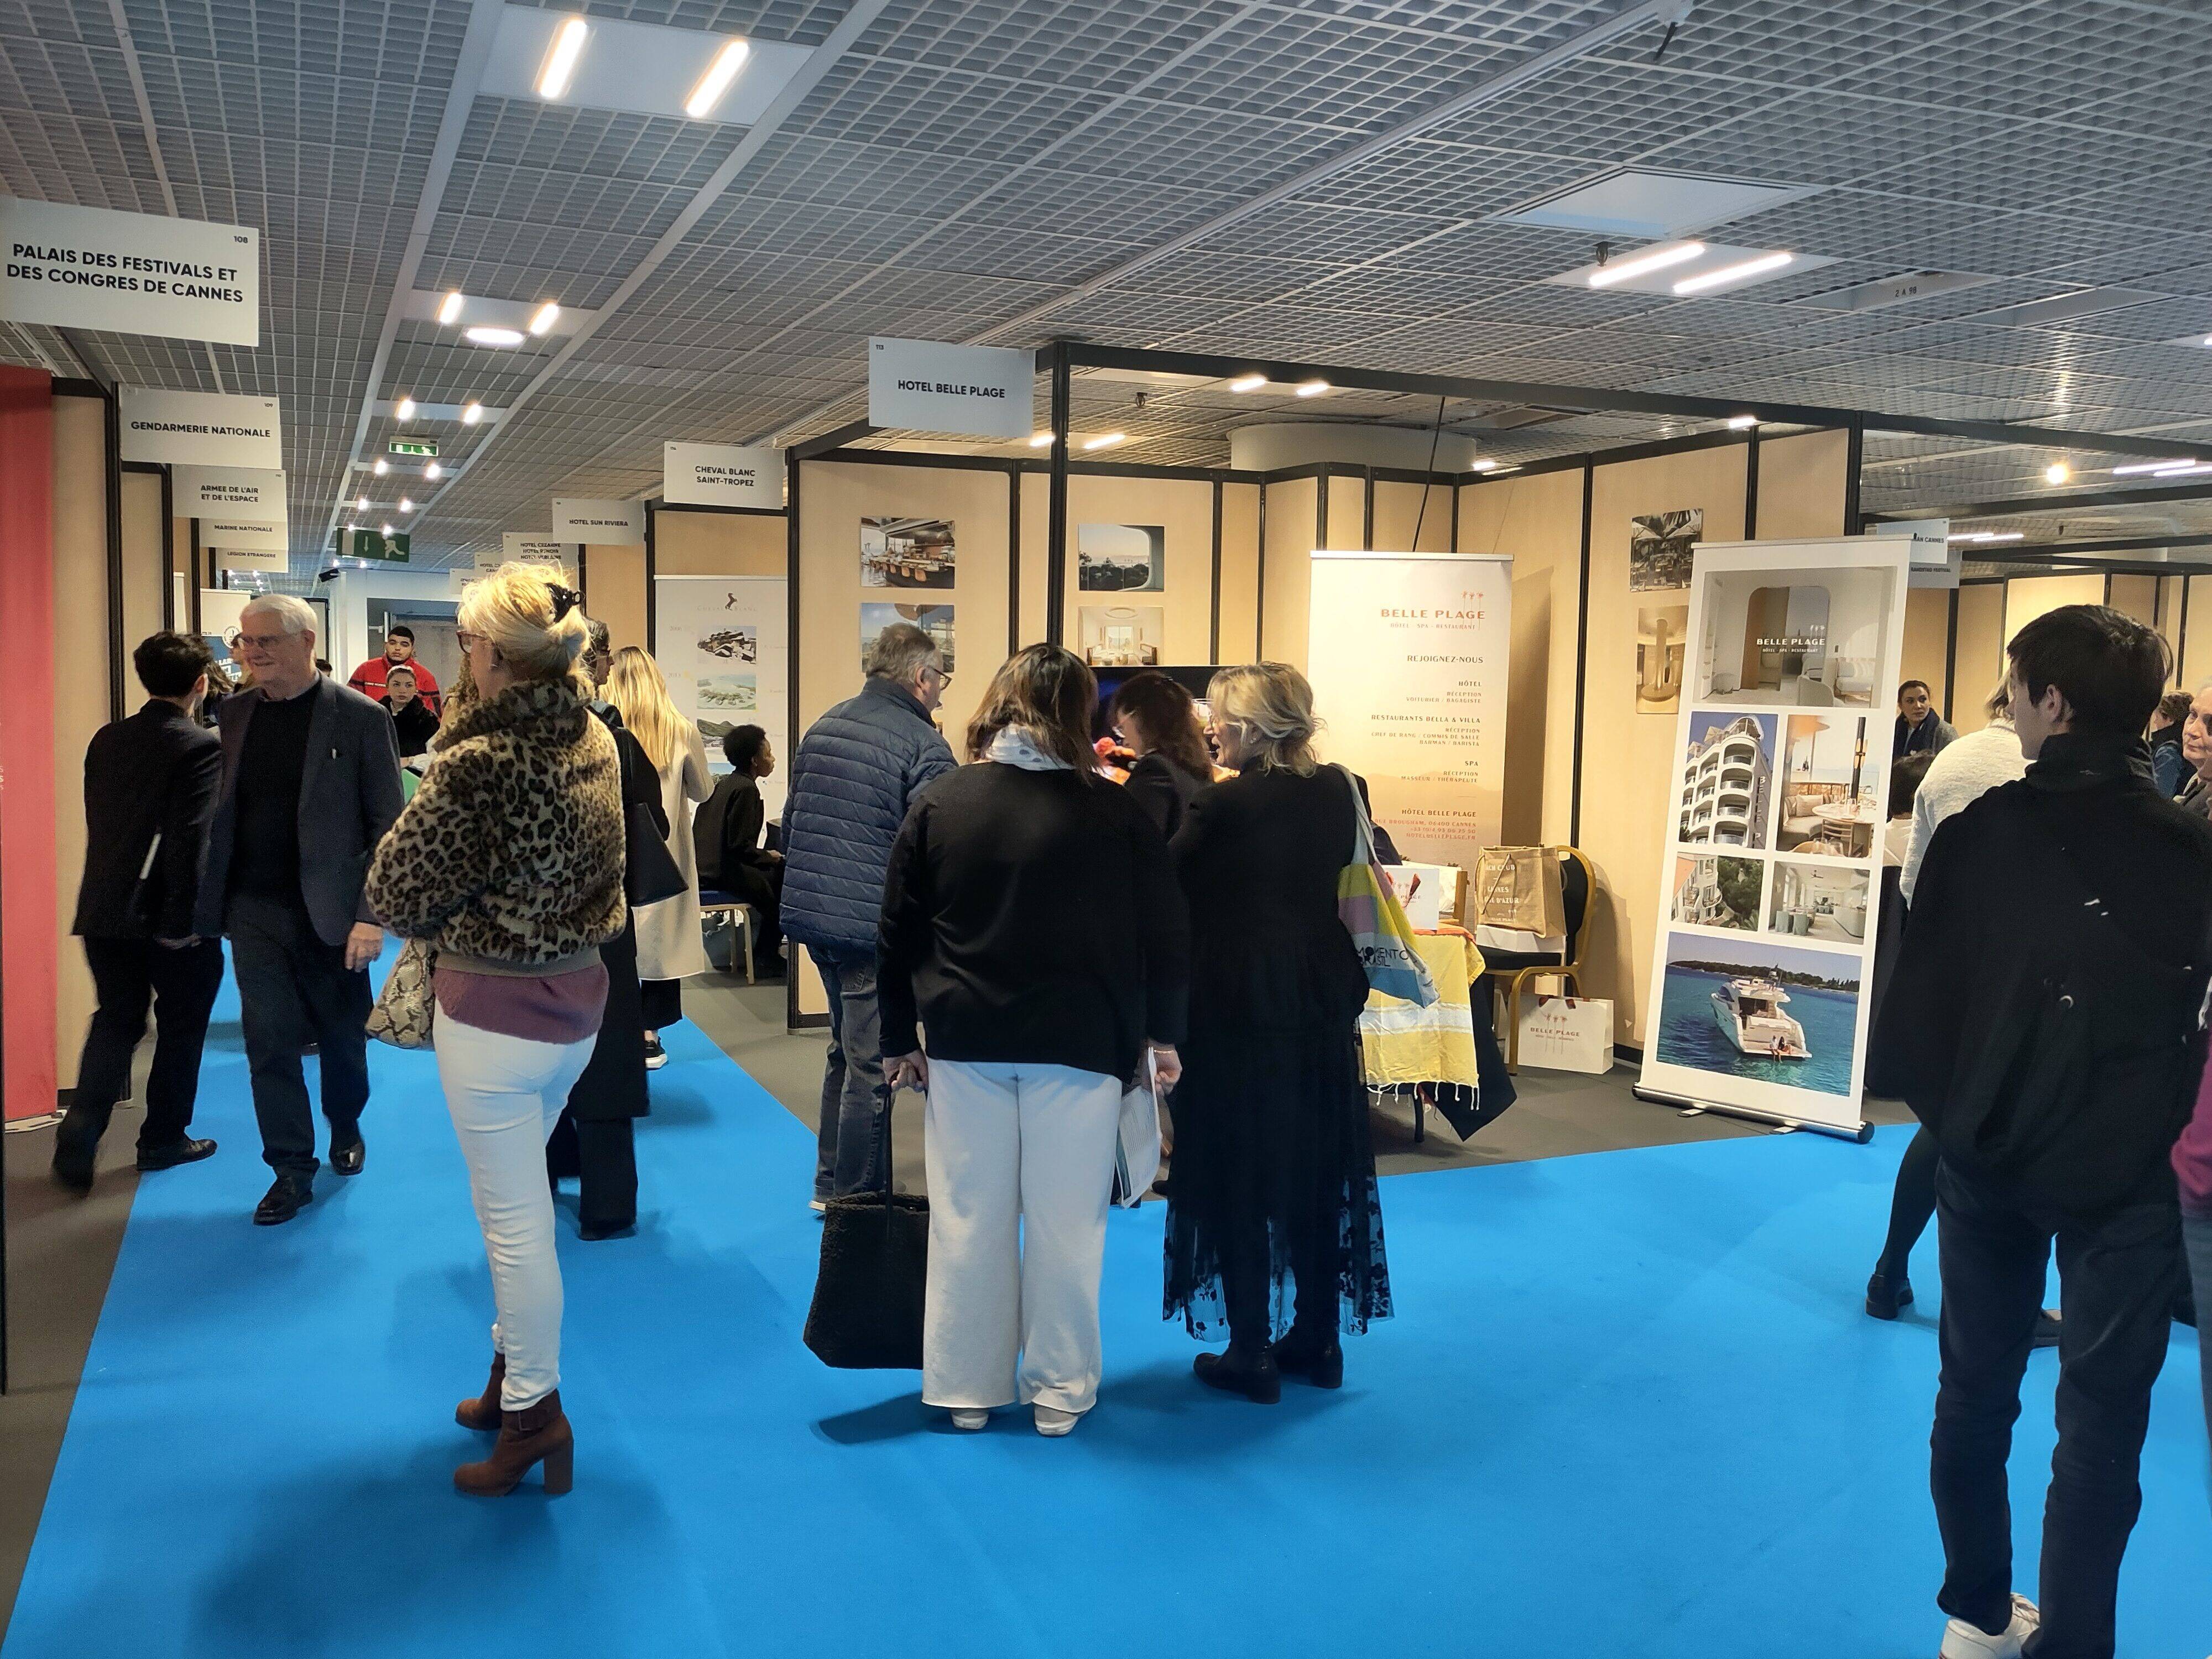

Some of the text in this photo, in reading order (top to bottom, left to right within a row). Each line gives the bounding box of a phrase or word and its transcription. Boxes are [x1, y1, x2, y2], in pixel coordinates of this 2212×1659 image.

[234, 235, 248, 243] 108
[13, 243, 237, 281] PALAIS DES FESTIVALS ET
[7, 264, 243, 302] DES CONGRES DE CANNES
[1909, 286, 1917, 295] 98
[898, 380, 1005, 398] HOTEL BELLE PLAGE
[131, 421, 271, 437] GENDARMERIE NATIONALE
[695, 465, 755, 477] CHEVAL BLANC
[696, 476, 754, 487] SAINT-TROPEZ
[1381, 609, 1485, 619] BELLE PLAGE
[1407, 655, 1483, 664] REJOIGNEZ-NOUS
